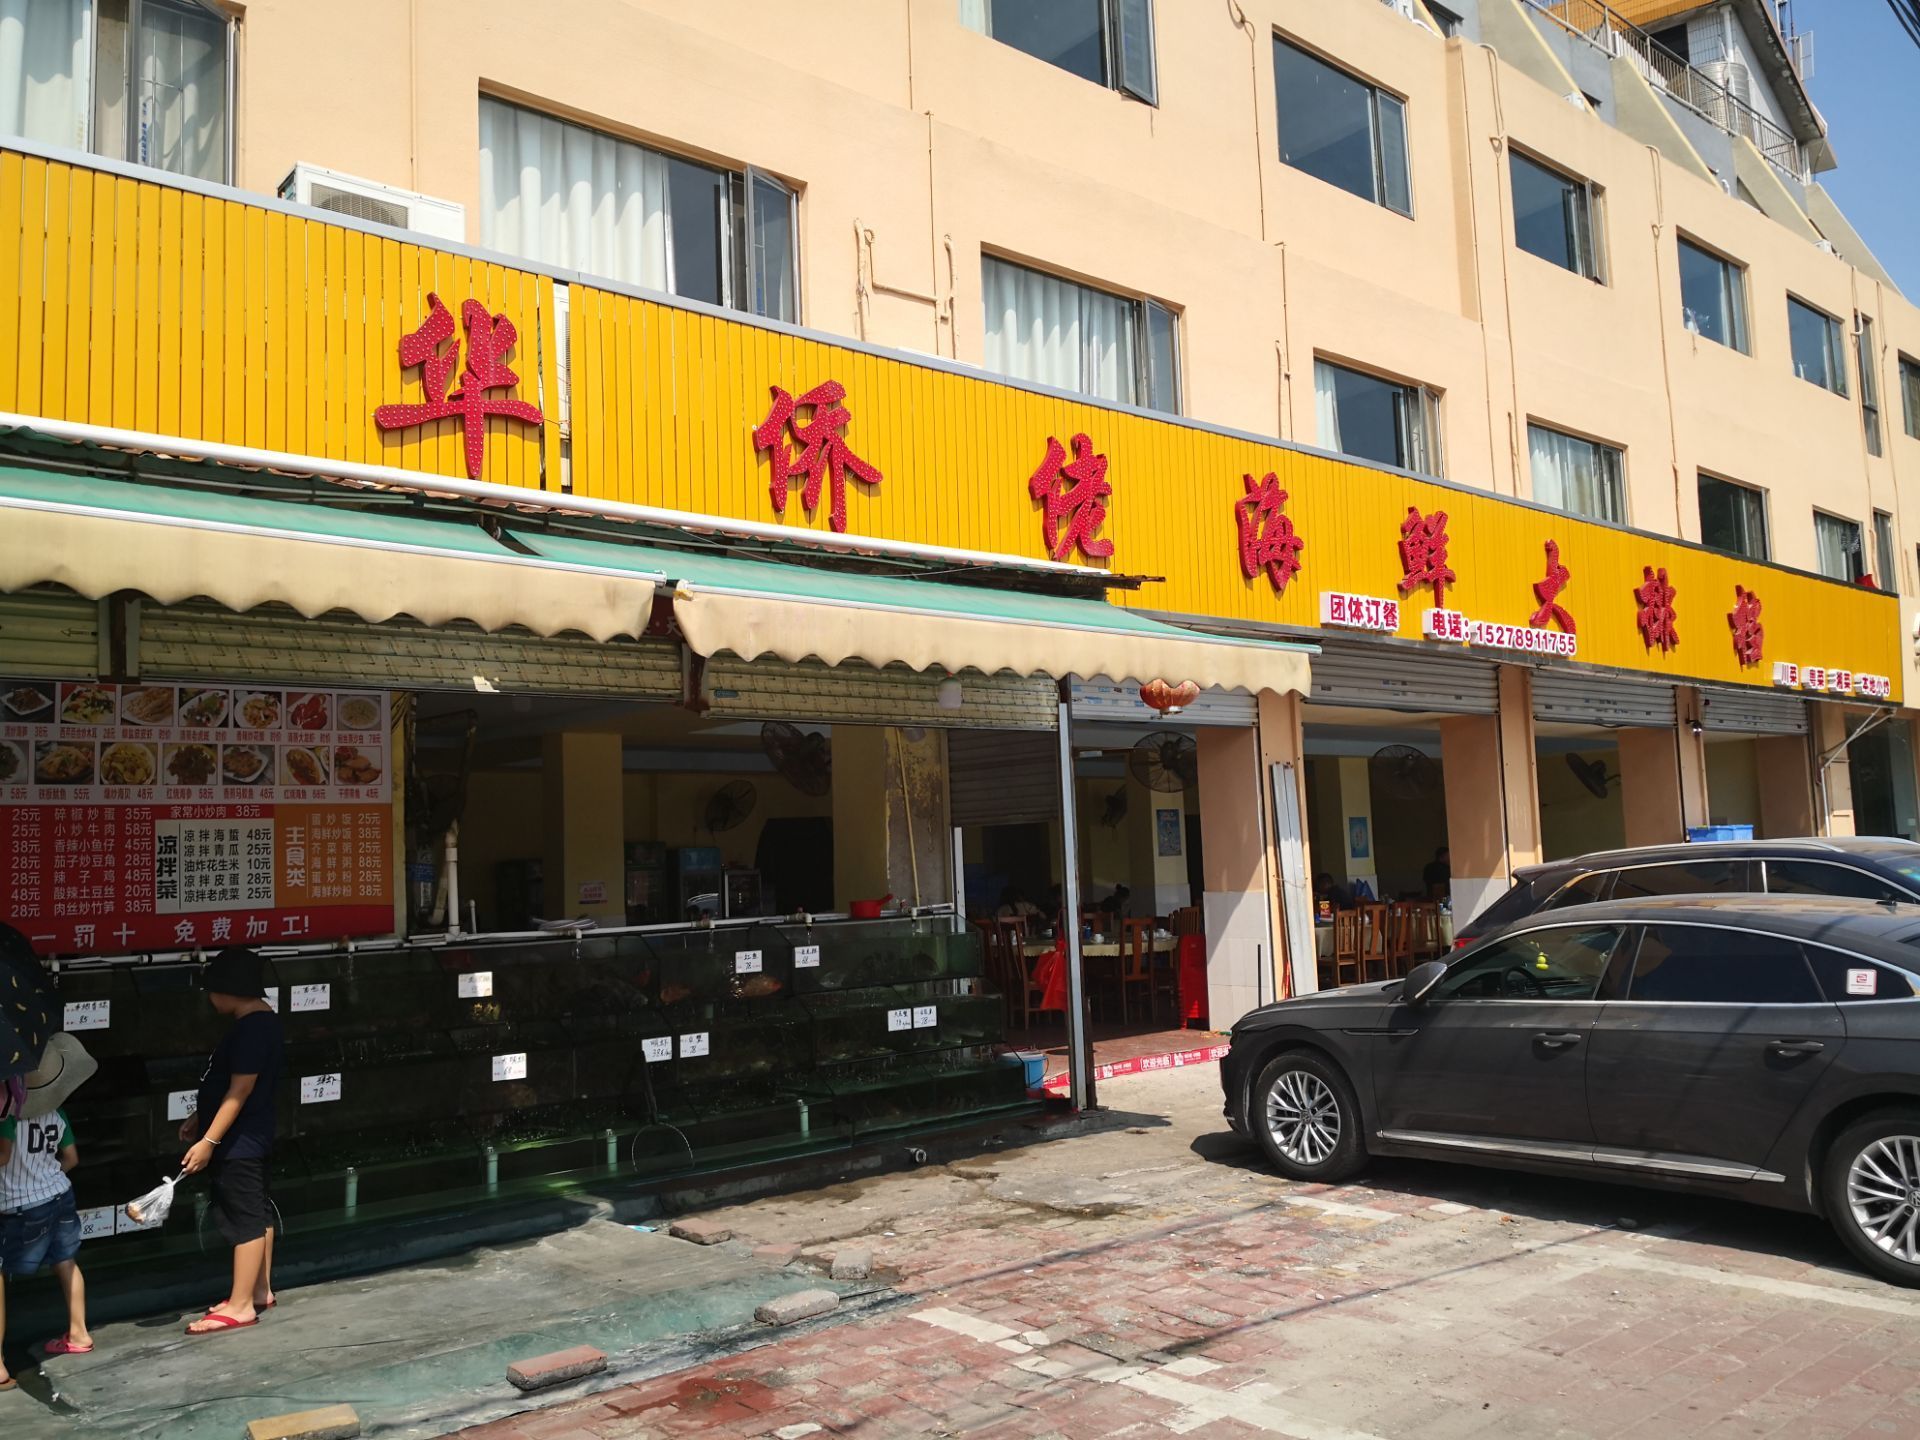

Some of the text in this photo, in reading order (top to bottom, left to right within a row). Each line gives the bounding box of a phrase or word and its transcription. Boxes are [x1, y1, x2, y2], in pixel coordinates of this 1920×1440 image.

[1330, 594, 1399, 629] 团体订餐
[1781, 664, 1890, 696] 川菜 粤菜 湘菜 本地小炒
[73, 788, 90, 801] 55元
[137, 787, 154, 801] 48元
[11, 808, 41, 821] 25元
[124, 807, 152, 820] 35元
[170, 805, 261, 819] 家常小炒肉 38元
[358, 813, 382, 825] 25元
[11, 823, 152, 837] 25元 小炒牛肉 58元
[246, 829, 272, 841] 48元
[311, 827, 382, 840] 海鲜炒饭 38元
[11, 838, 152, 853] 38元 香辣小鱼仔 45元
[184, 843, 272, 857] 凉拌青瓜 25元
[358, 842, 382, 854] 25元
[11, 854, 152, 869] 28元 茄子炒豆角 28元
[284, 826, 306, 888] 主食类
[156, 834, 178, 900] 凉拌菜
[184, 858, 272, 873] 油炸花生米 10元
[11, 869, 152, 885] 28元 辣子鸡 48元
[184, 873, 272, 887] 凉拌皮蛋 28元
[358, 870, 382, 882] 28元
[11, 884, 152, 901] 48元 酸辣土豆丝 20元
[184, 888, 272, 903] 凉拌老虎菜 25元
[311, 885, 382, 898] 海鲜炒粉 38元
[11, 900, 152, 918] 28元 肉丝炒竹笋 38元
